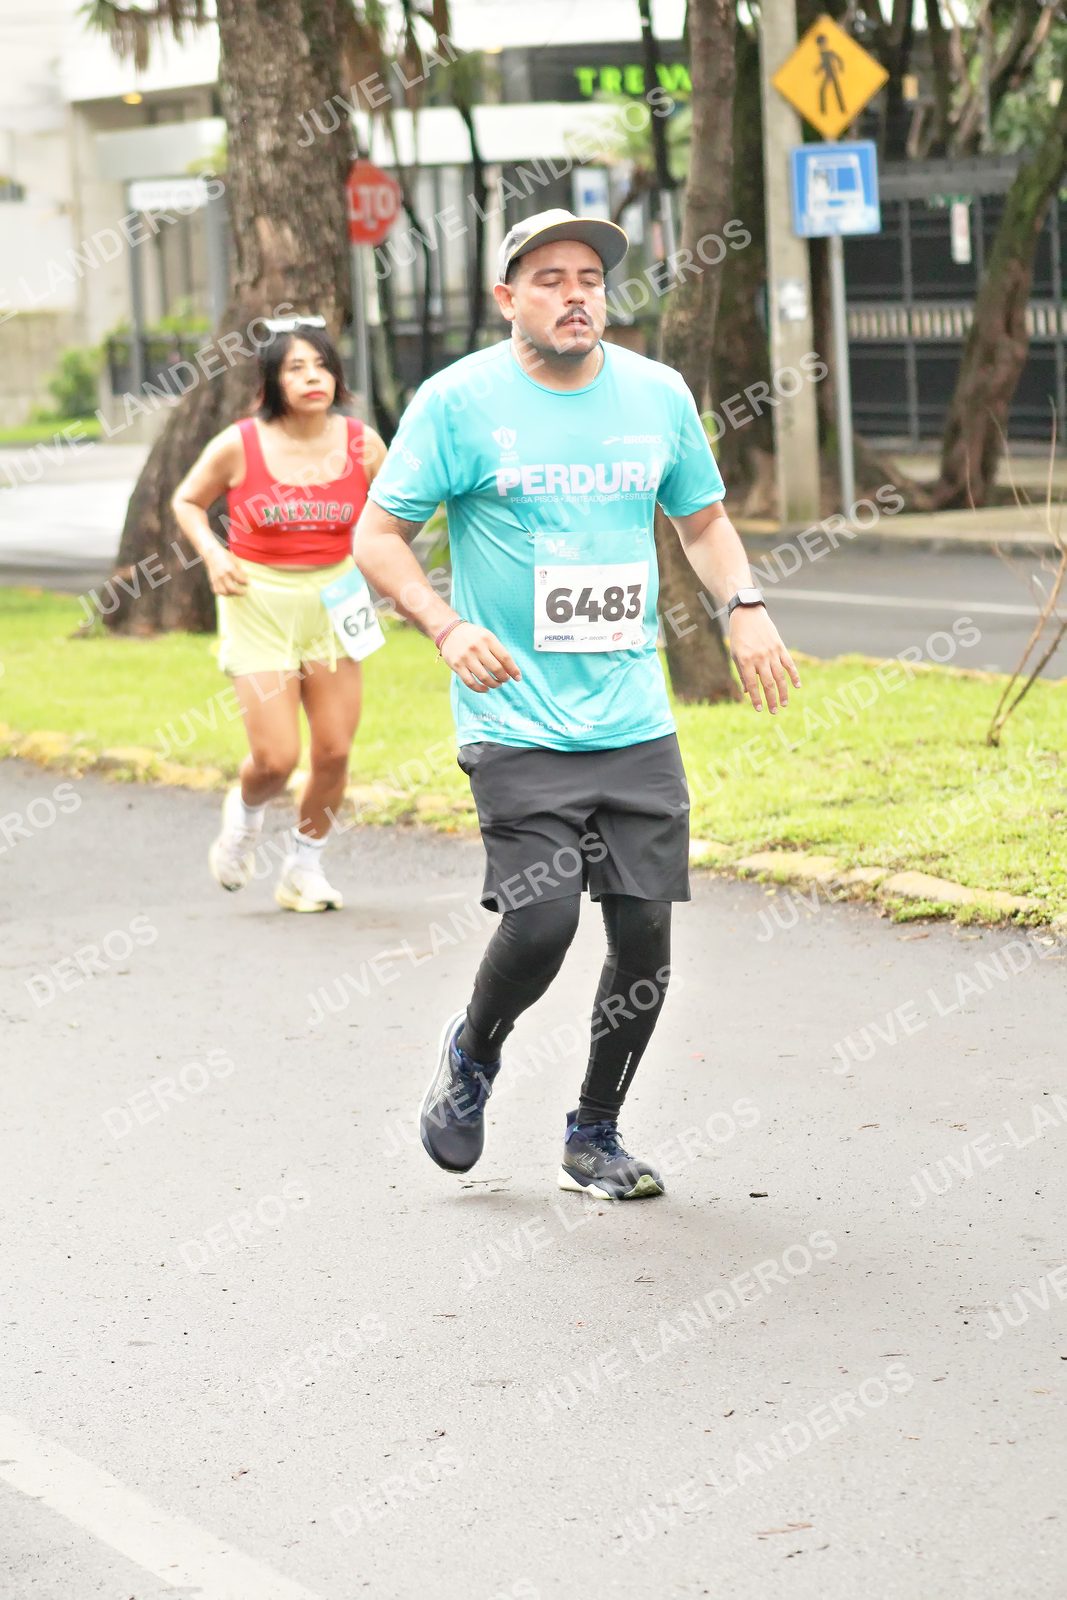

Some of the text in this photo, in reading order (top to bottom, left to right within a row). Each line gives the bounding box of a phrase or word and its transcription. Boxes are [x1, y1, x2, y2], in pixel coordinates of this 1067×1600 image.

[346, 185, 398, 224] LTO
[495, 461, 658, 496] PERDURA
[510, 496, 533, 504] PEGA
[534, 495, 559, 503] PISOS
[545, 584, 642, 623] 6483
[343, 607, 375, 636] 62
